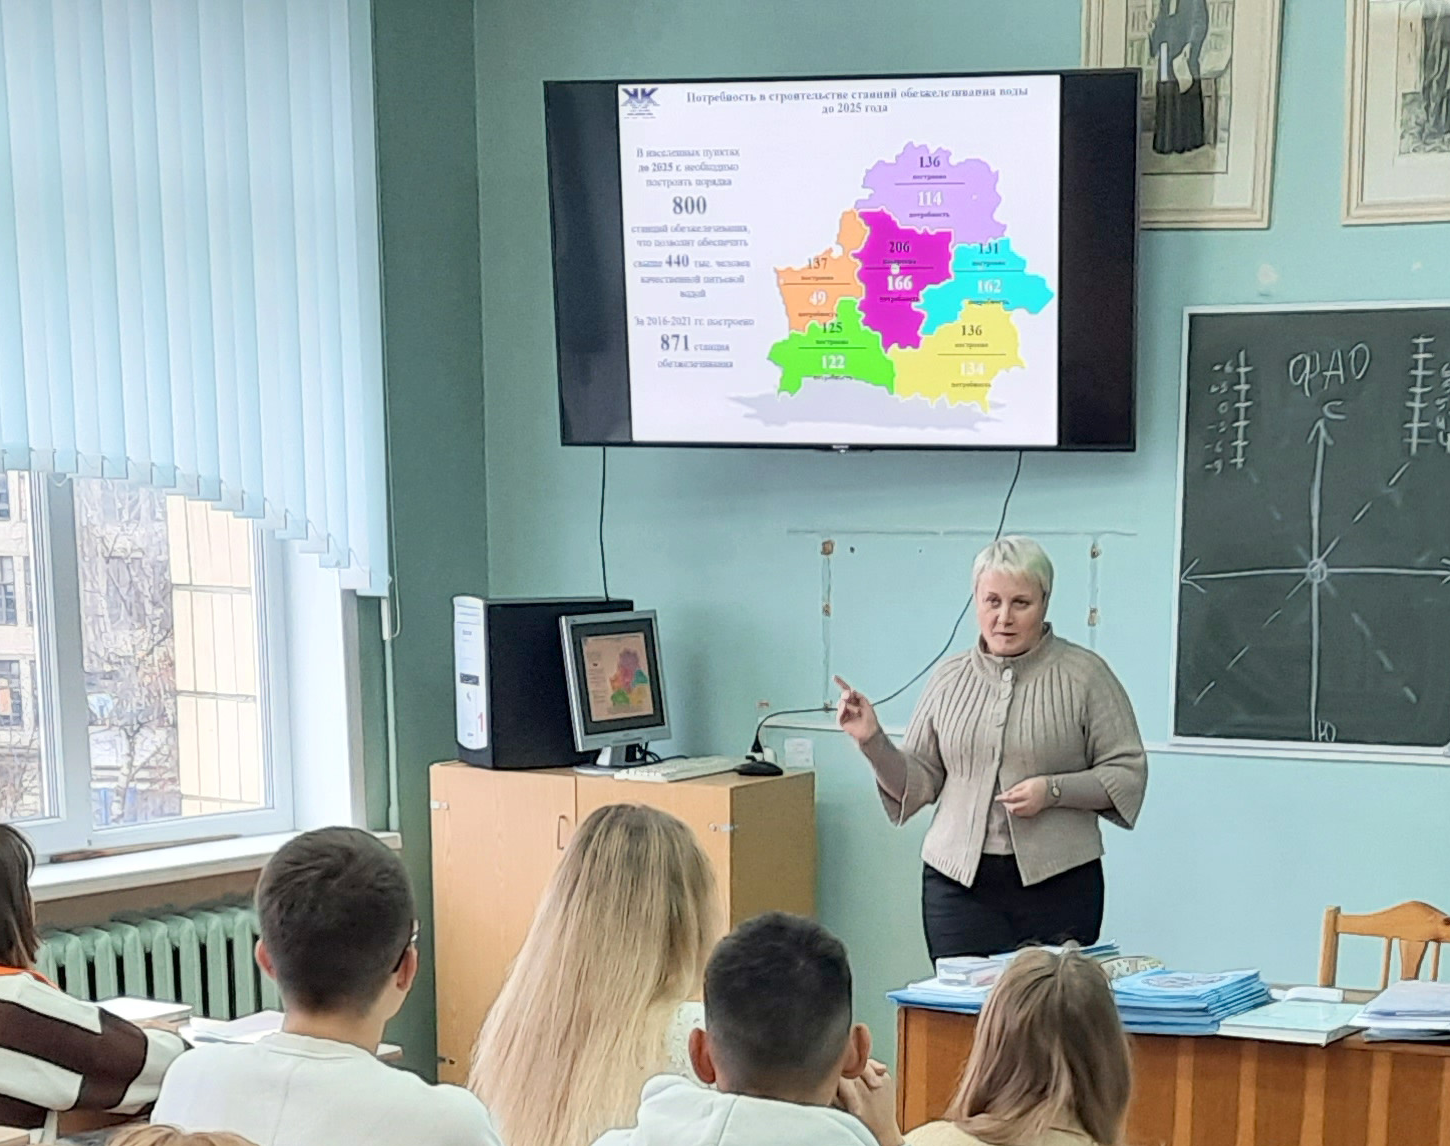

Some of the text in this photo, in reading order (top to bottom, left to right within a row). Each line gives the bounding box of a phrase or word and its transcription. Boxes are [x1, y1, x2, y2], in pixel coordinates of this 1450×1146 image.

[837, 102, 862, 114] 2025
[919, 155, 941, 168] 136
[672, 195, 707, 215] 800
[918, 191, 942, 207] 114
[889, 241, 910, 253] 206
[665, 254, 690, 268] 440
[806, 257, 828, 270] 137
[887, 275, 914, 291] 166
[808, 290, 827, 306] 49
[822, 322, 843, 334] 125
[961, 324, 983, 337] 136
[660, 333, 690, 352] 871
[822, 354, 846, 370] 122
